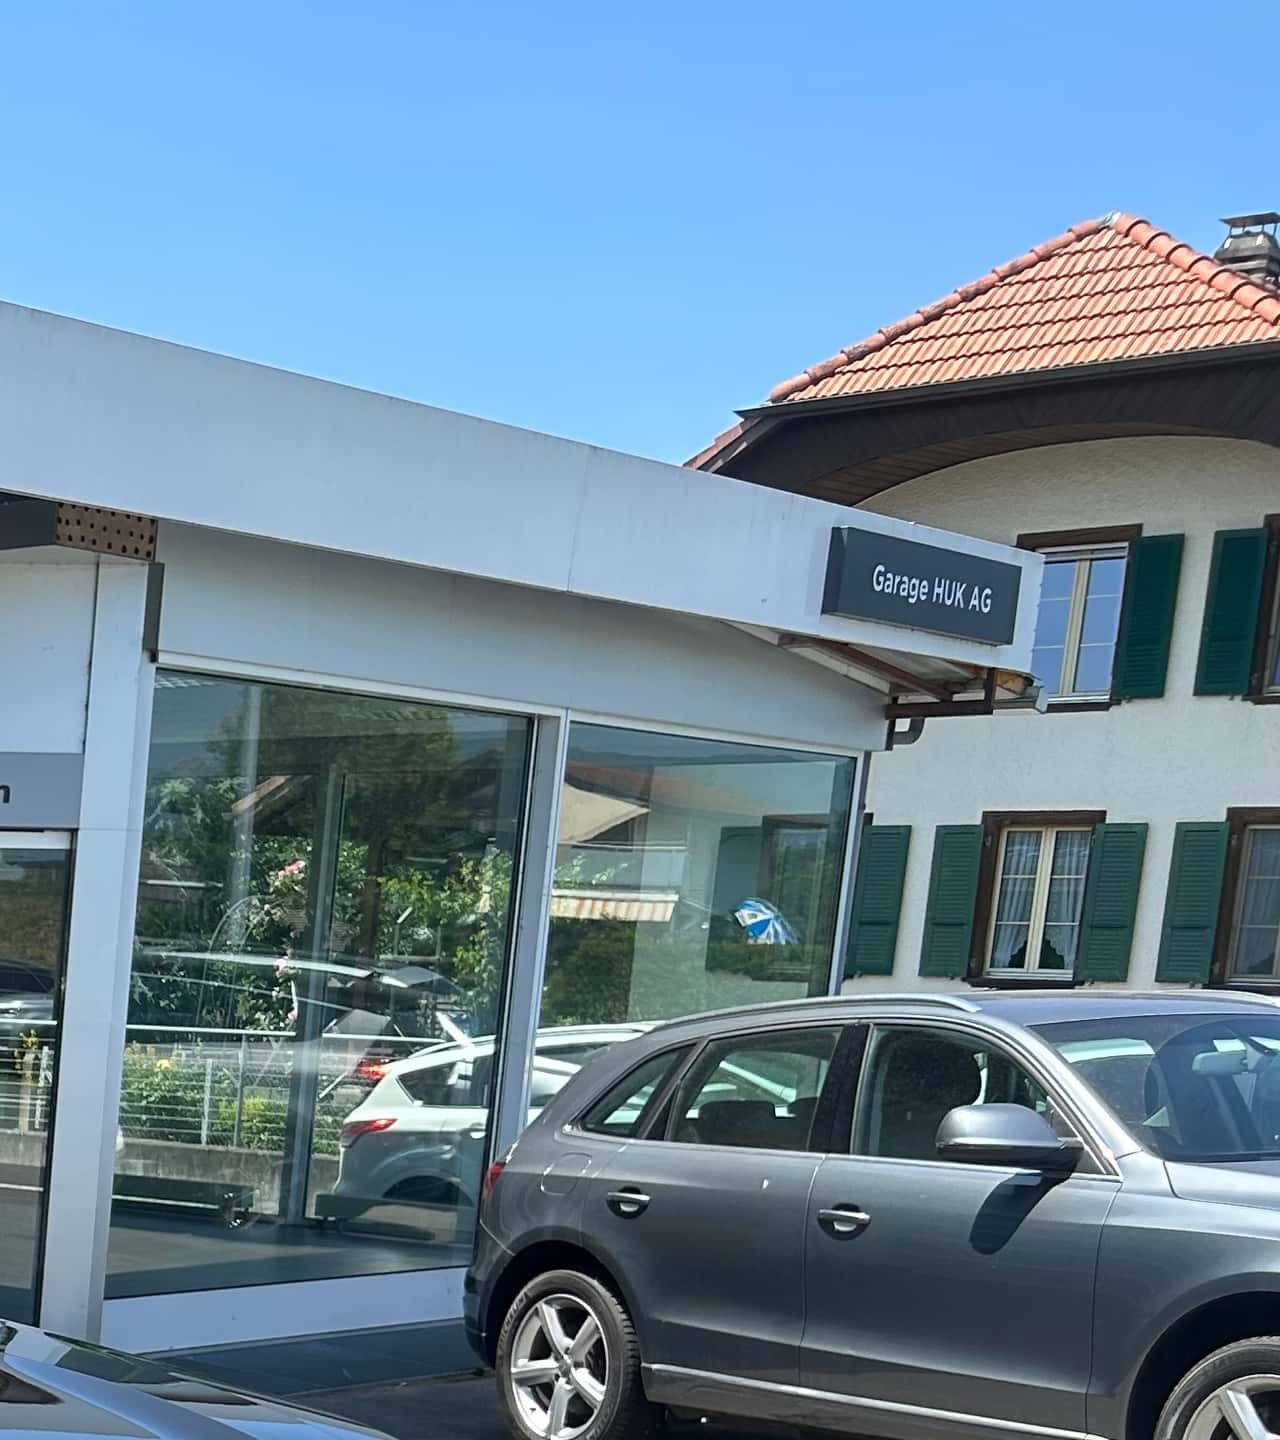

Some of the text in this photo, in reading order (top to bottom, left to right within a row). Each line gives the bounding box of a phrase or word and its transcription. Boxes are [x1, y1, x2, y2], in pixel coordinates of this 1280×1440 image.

[873, 564, 992, 613] Garage HUK AG
